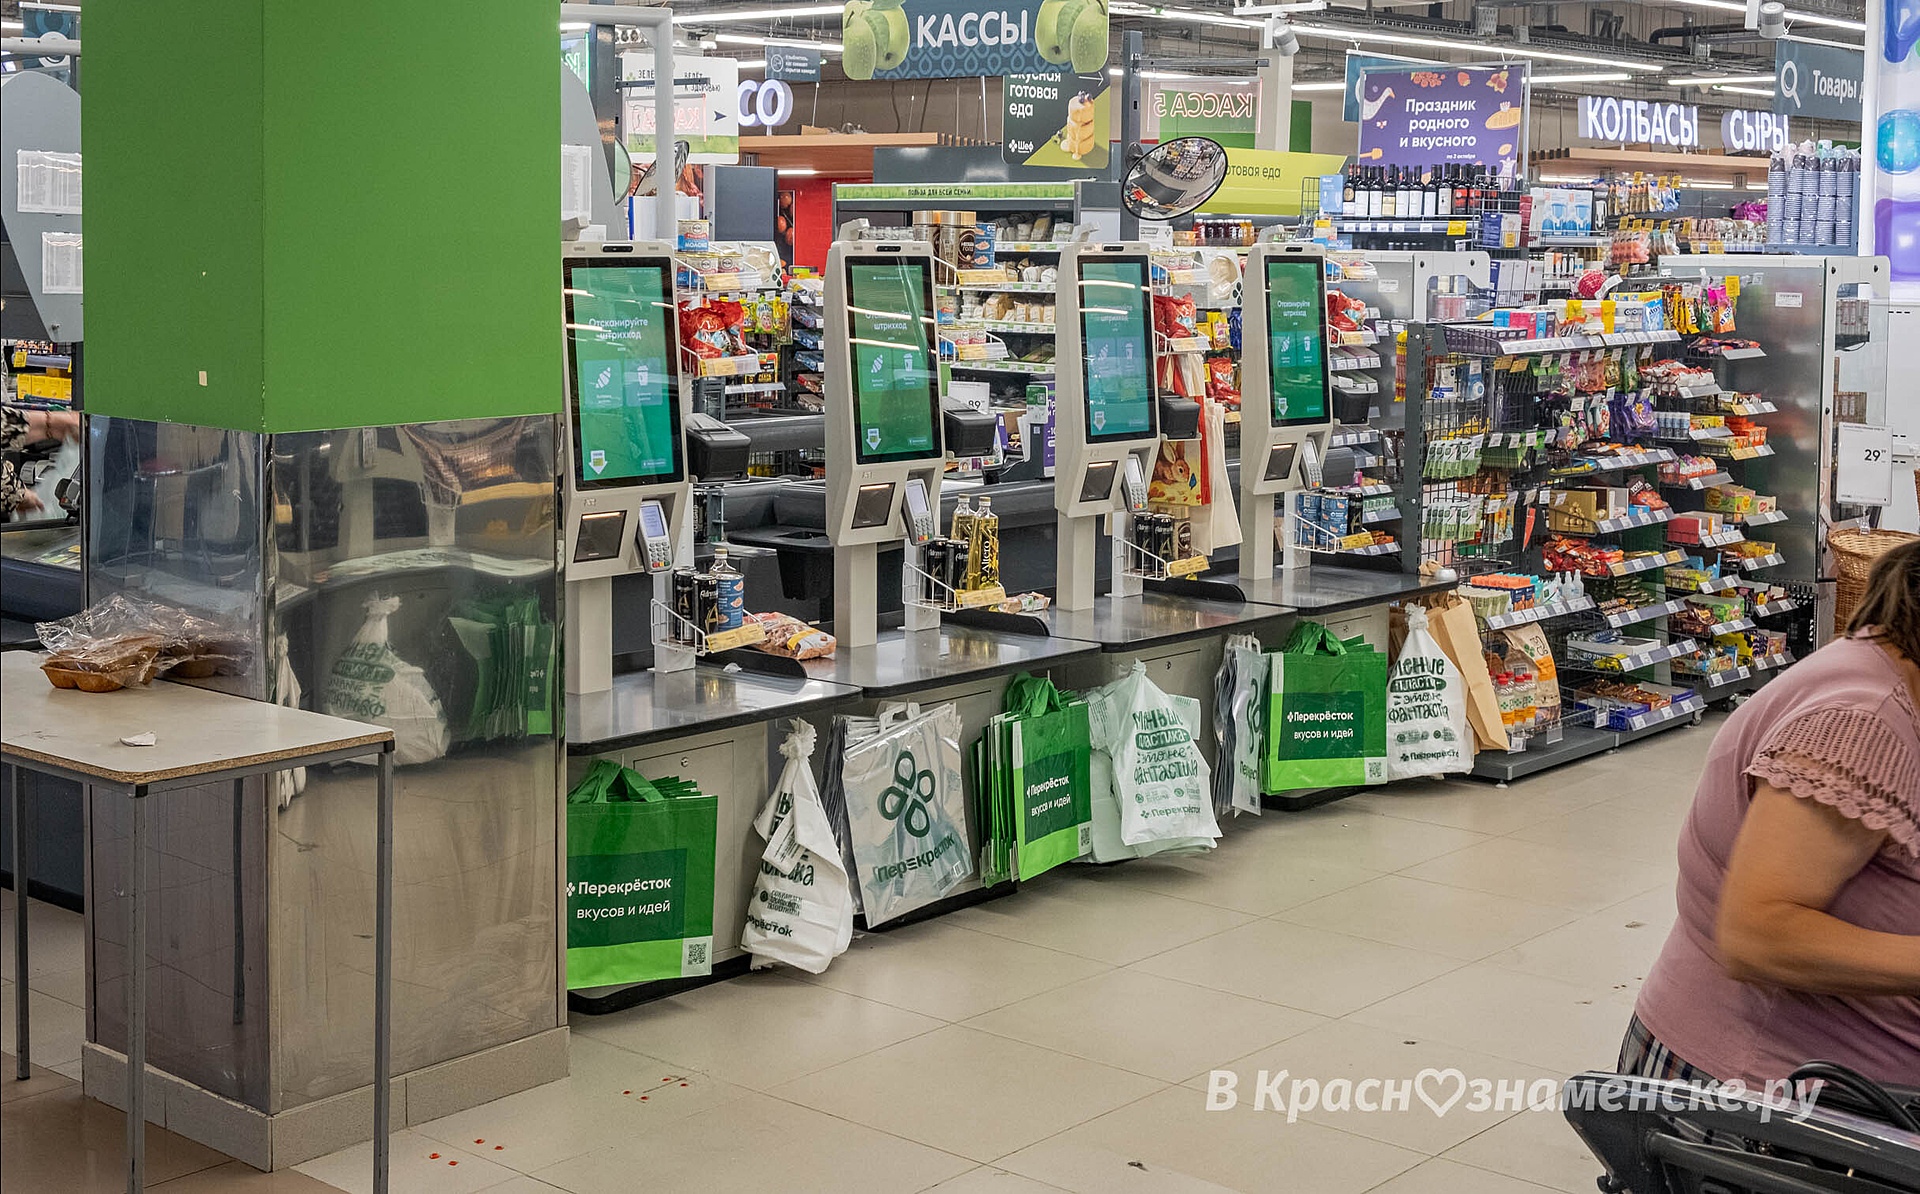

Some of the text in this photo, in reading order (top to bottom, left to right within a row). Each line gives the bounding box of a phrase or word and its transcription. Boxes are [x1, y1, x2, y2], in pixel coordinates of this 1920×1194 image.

[917, 9, 1028, 48] КАССЫ
[1009, 84, 1058, 100] готовая
[1812, 69, 1858, 105] Товары
[1009, 103, 1034, 118] еда
[1405, 98, 1476, 115] Праздник
[1409, 116, 1470, 133] родного
[1586, 95, 1699, 147] КОЛБАСЫ
[1728, 109, 1790, 151] СЫРЫ
[1399, 135, 1477, 150] и вкусного
[1225, 164, 1281, 180] отовая еда
[588, 316, 649, 329] Отсканируйте
[873, 321, 908, 332] штрихкод
[1864, 448, 1881, 462] 29
[981, 540, 991, 579] Altero
[1293, 710, 1354, 723] Перекрёсток
[1294, 727, 1353, 744] вкусов и идей
[1030, 774, 1070, 797] Перекрёсток
[1054, 794, 1071, 810] идей
[578, 877, 672, 897] Перекрёсток
[576, 899, 671, 922] вкусов и идей
